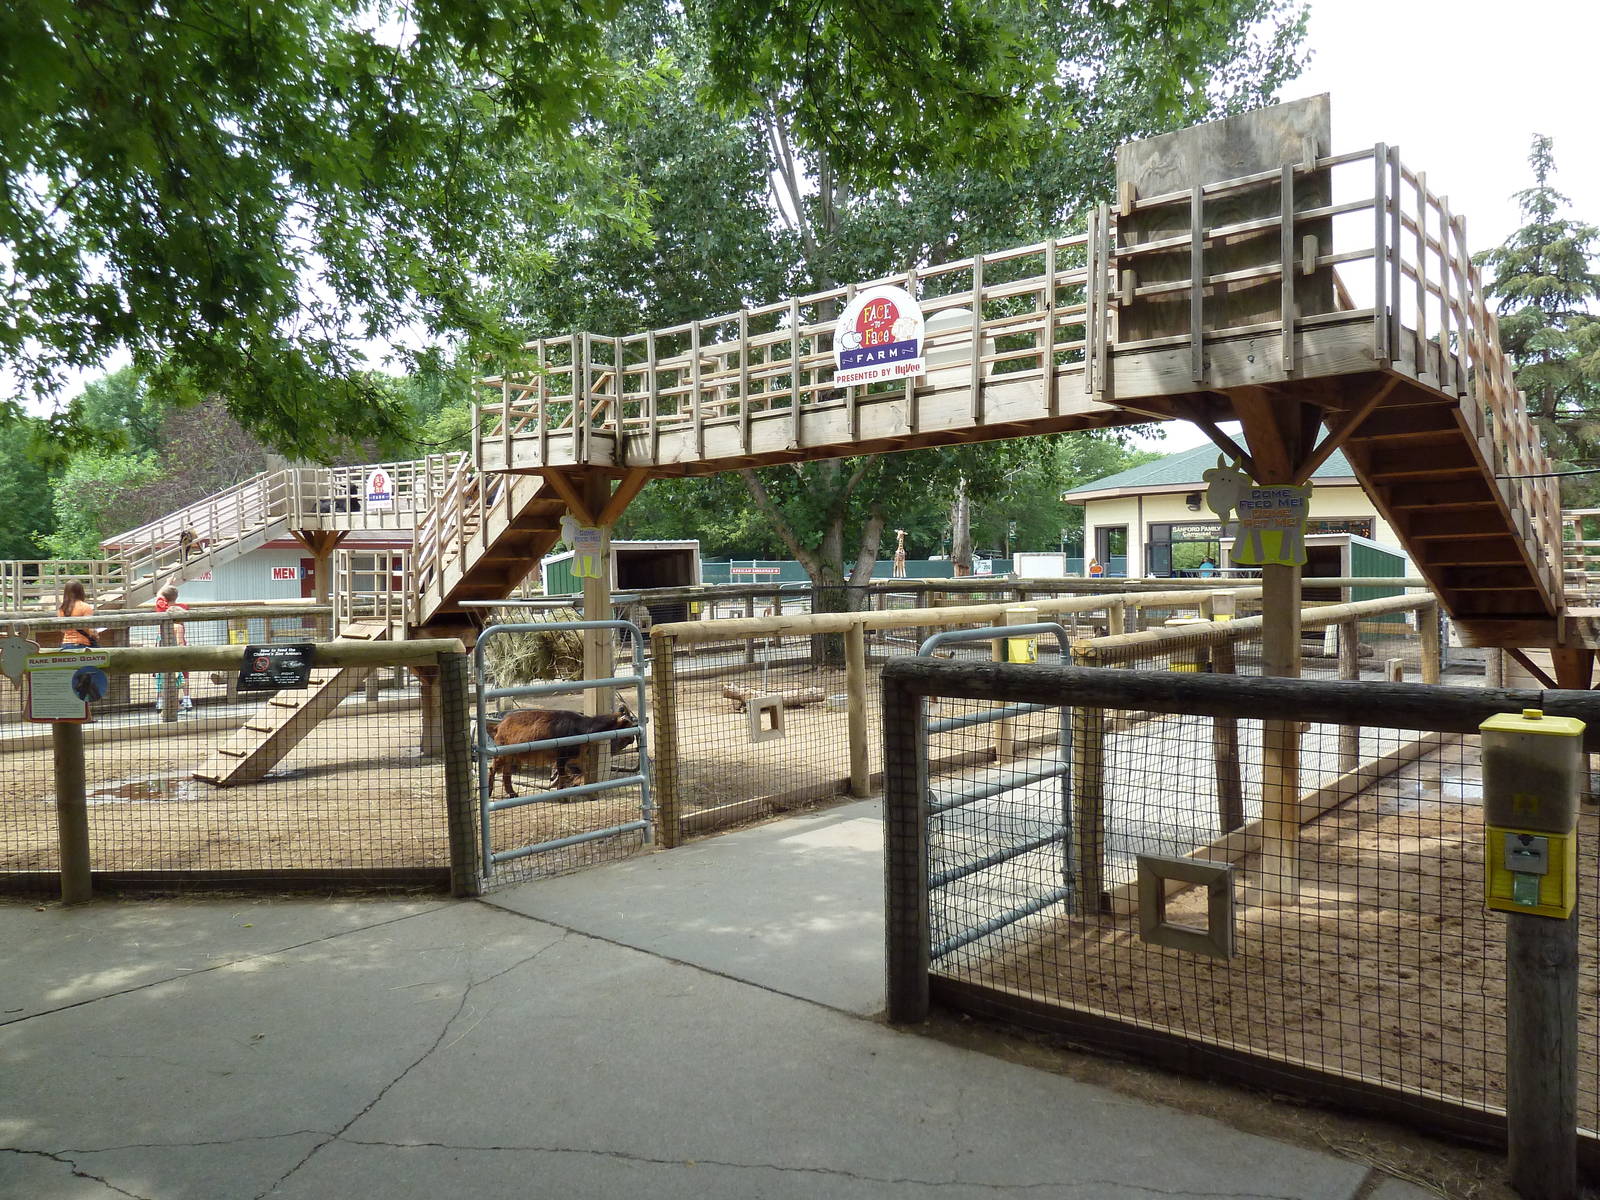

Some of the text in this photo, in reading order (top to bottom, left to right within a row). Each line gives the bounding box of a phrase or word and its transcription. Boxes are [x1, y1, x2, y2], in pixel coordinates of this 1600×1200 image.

[863, 303, 893, 323] FACE
[856, 348, 898, 363] FARM
[836, 370, 879, 384] PRESENTED
[881, 368, 891, 377] BY
[1252, 489, 1290, 499] COME
[1240, 497, 1303, 509] FEED ME!
[273, 567, 296, 579] MEN
